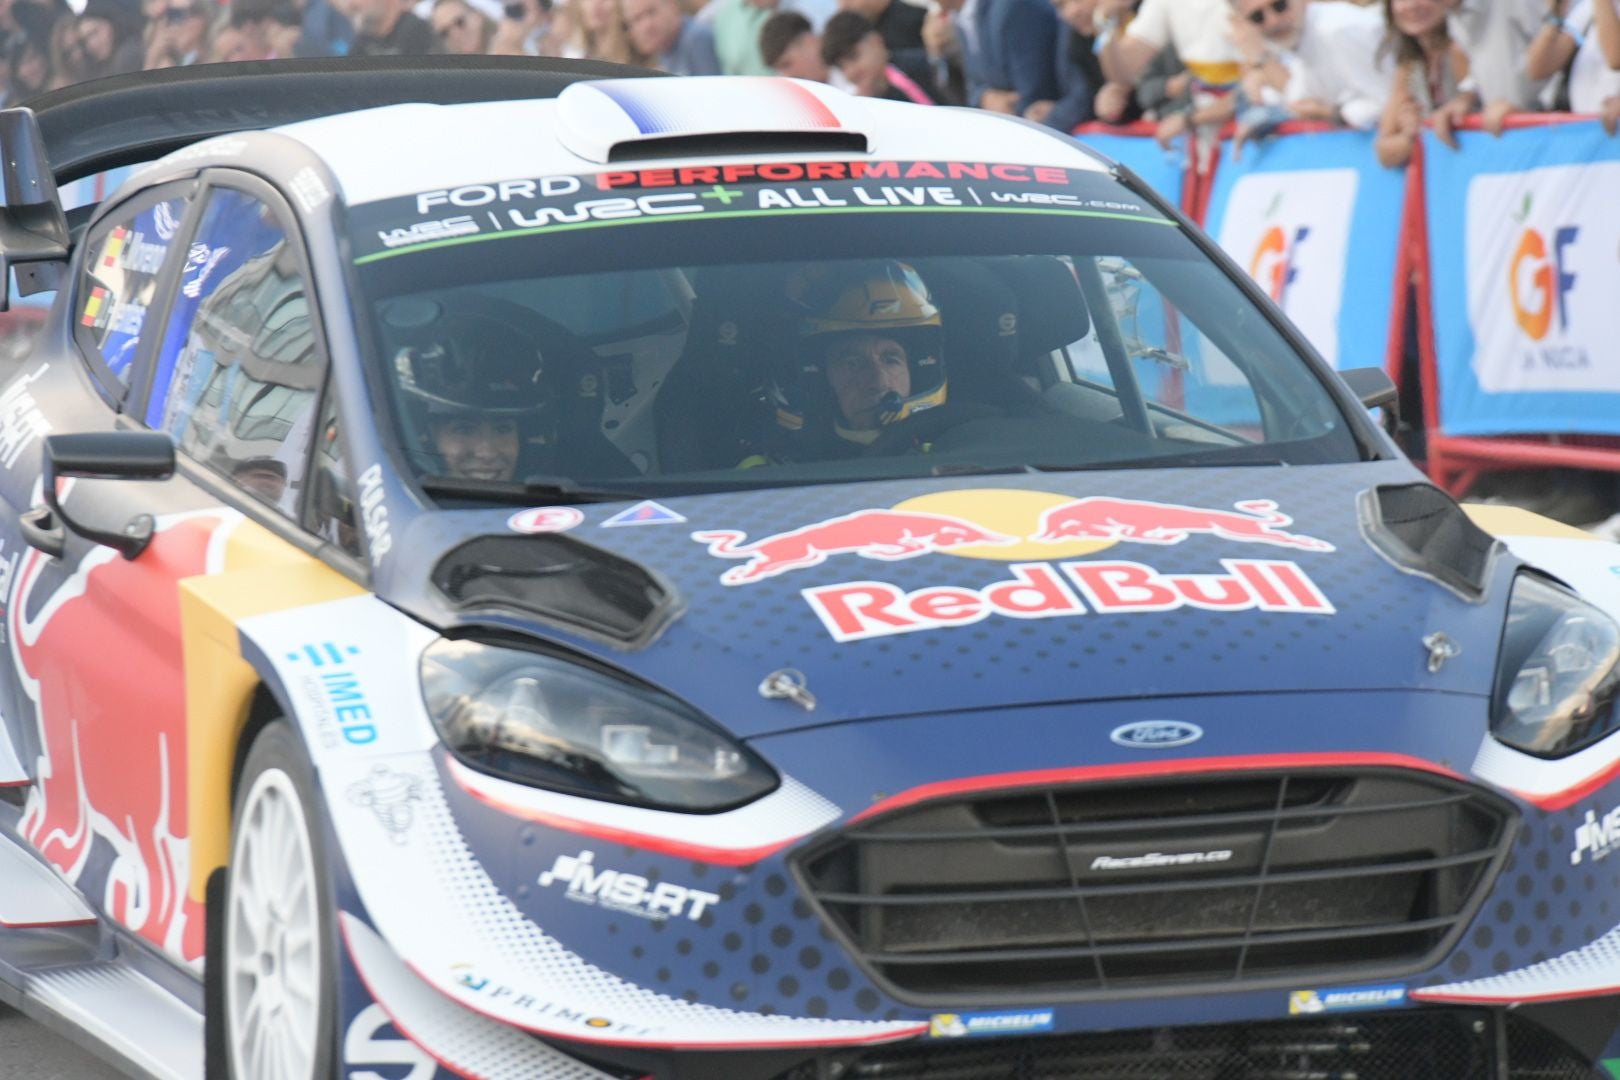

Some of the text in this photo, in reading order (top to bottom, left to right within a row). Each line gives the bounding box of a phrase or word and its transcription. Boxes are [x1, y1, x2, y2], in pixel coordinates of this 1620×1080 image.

[416, 160, 1070, 214] FORD PERFORMANCE
[758, 187, 848, 209] ALL
[852, 185, 963, 207] LIVE
[1508, 225, 1579, 342] GF
[321, 672, 378, 744] IMED
[1324, 988, 1405, 1004] MICHELIN
[967, 1012, 1053, 1028] MICHELIN
